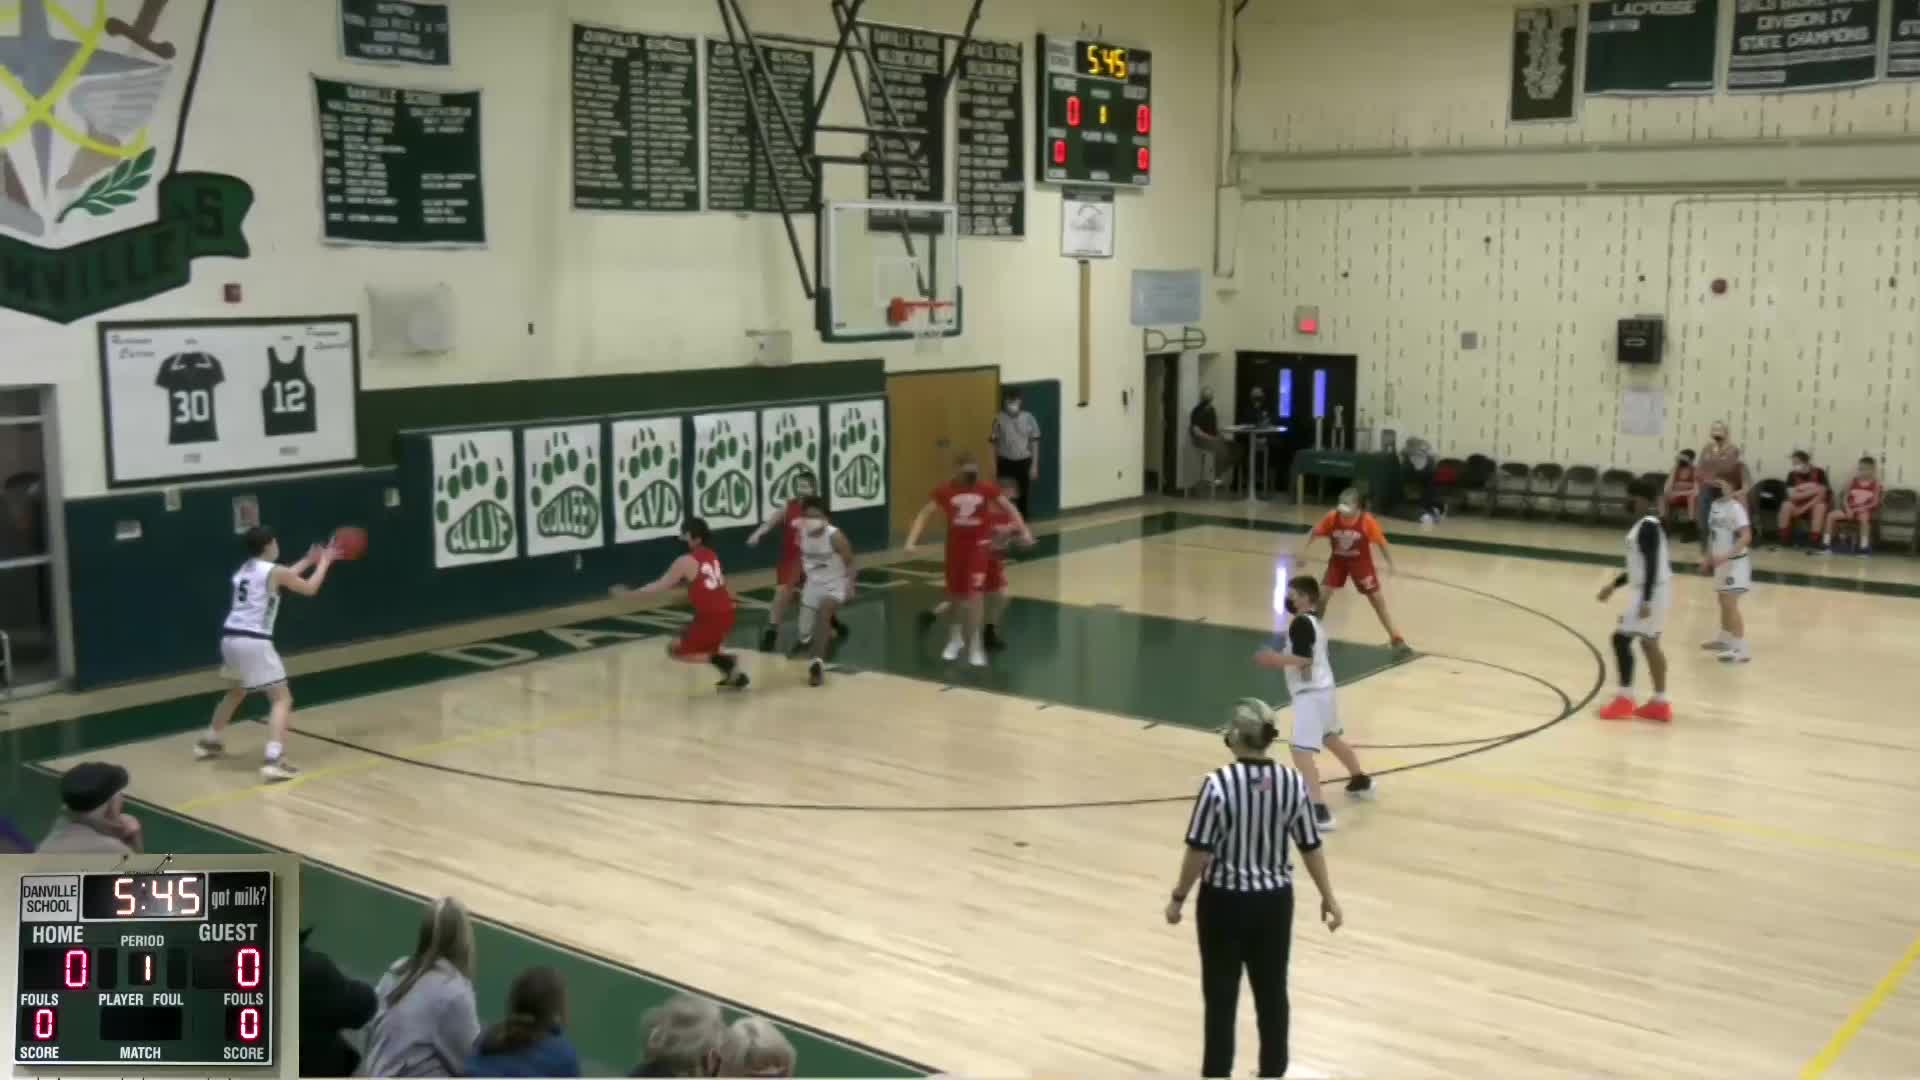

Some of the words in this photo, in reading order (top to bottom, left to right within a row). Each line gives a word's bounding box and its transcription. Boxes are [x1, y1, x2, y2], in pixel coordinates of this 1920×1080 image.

[1067, 96, 1081, 127] 0
[1136, 103, 1151, 135] 0
[173, 390, 210, 424] 30
[272, 379, 306, 413] 12
[630, 483, 676, 528] AVA
